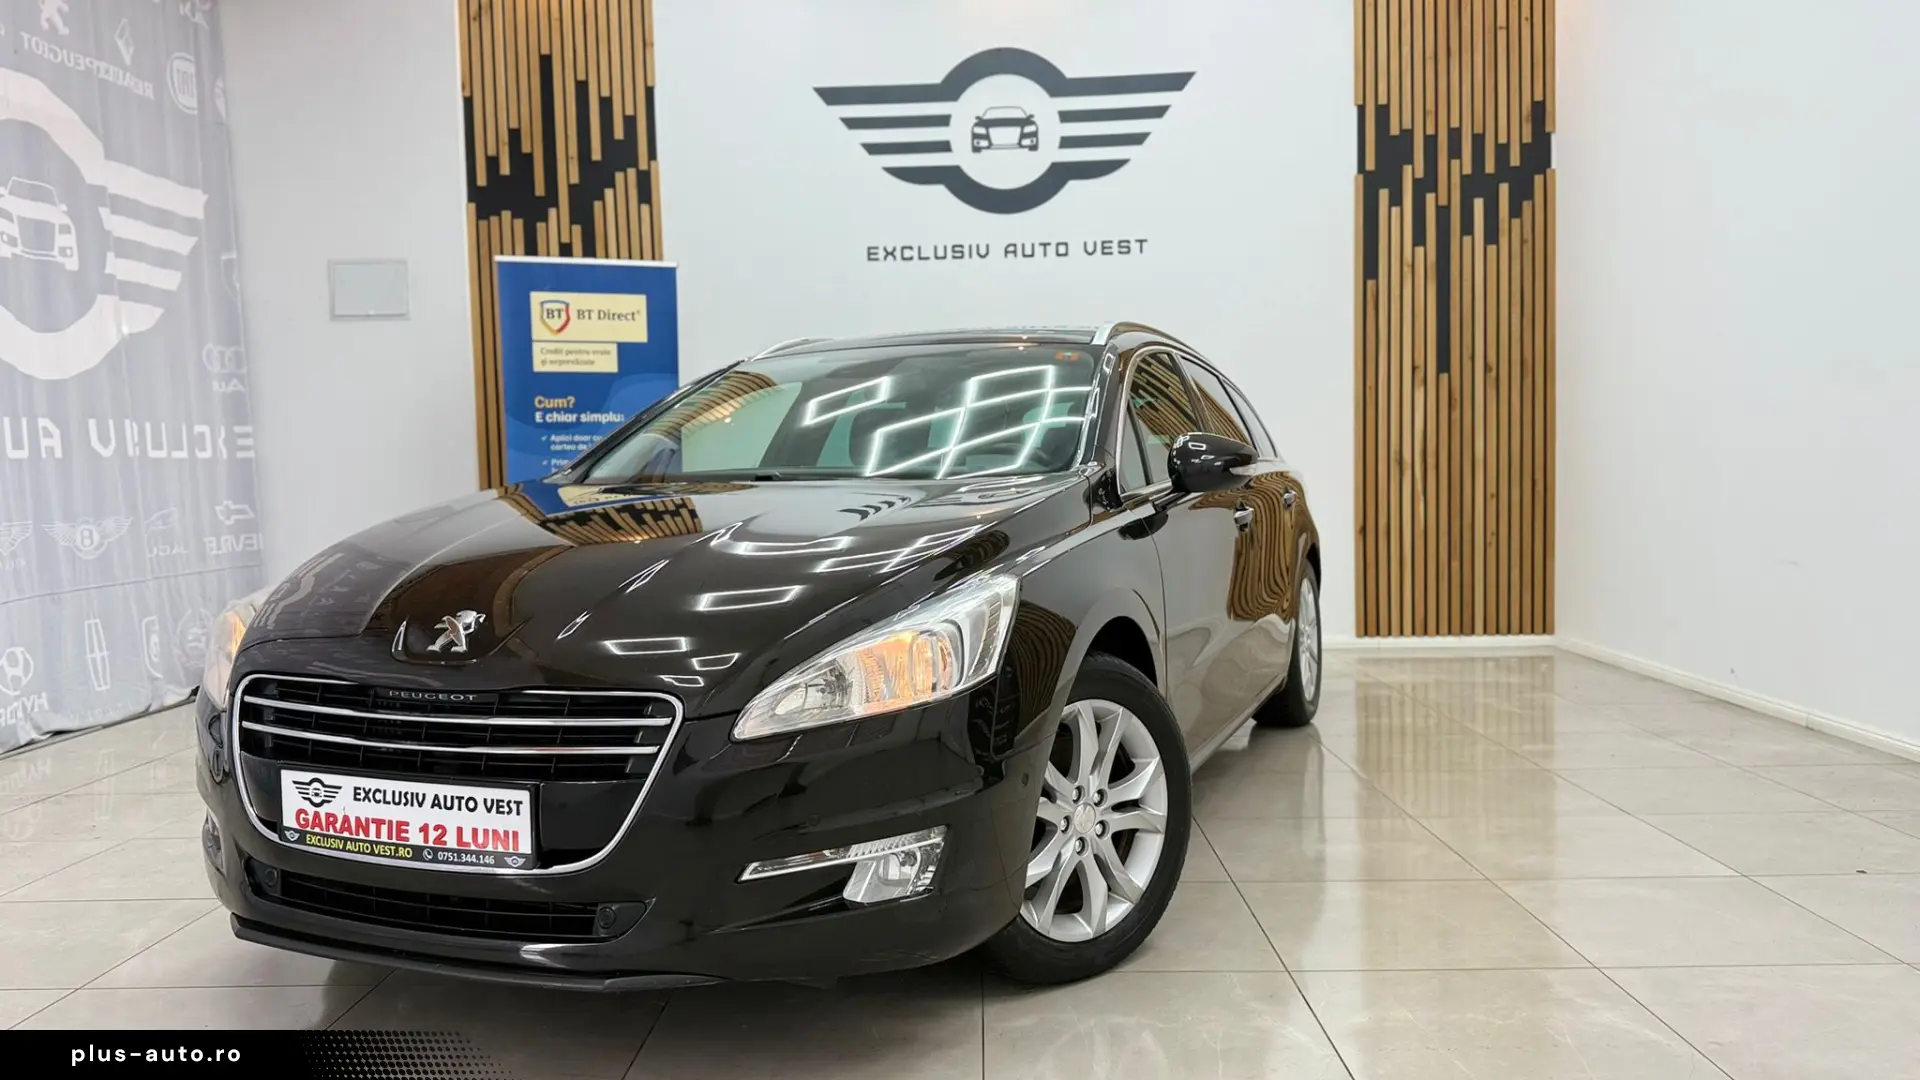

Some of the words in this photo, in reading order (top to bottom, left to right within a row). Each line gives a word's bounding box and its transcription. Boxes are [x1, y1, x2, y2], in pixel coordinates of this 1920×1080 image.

[867, 243, 990, 261] EXCLUSIV
[1003, 242, 1069, 258] AUTO
[1083, 239, 1148, 256] VEST
[546, 308, 564, 320] BT
[576, 309, 594, 320] BT
[534, 396, 576, 409] Cum?
[535, 412, 544, 423] E
[545, 412, 578, 423] chiar
[580, 411, 625, 424] simplu:
[389, 690, 477, 701] PEUGEOT
[353, 786, 426, 808] EXCLUSIV
[430, 794, 478, 813] AUTO
[483, 797, 523, 816] VEST
[295, 808, 410, 843] GARANTIE
[418, 822, 448, 846] 12
[456, 826, 520, 852] LUNI
[306, 834, 344, 850] EXCLUSIV
[345, 840, 371, 853] AUTO
[373, 845, 413, 859] VEST.RO
[437, 851, 495, 865] 0751.344.146
